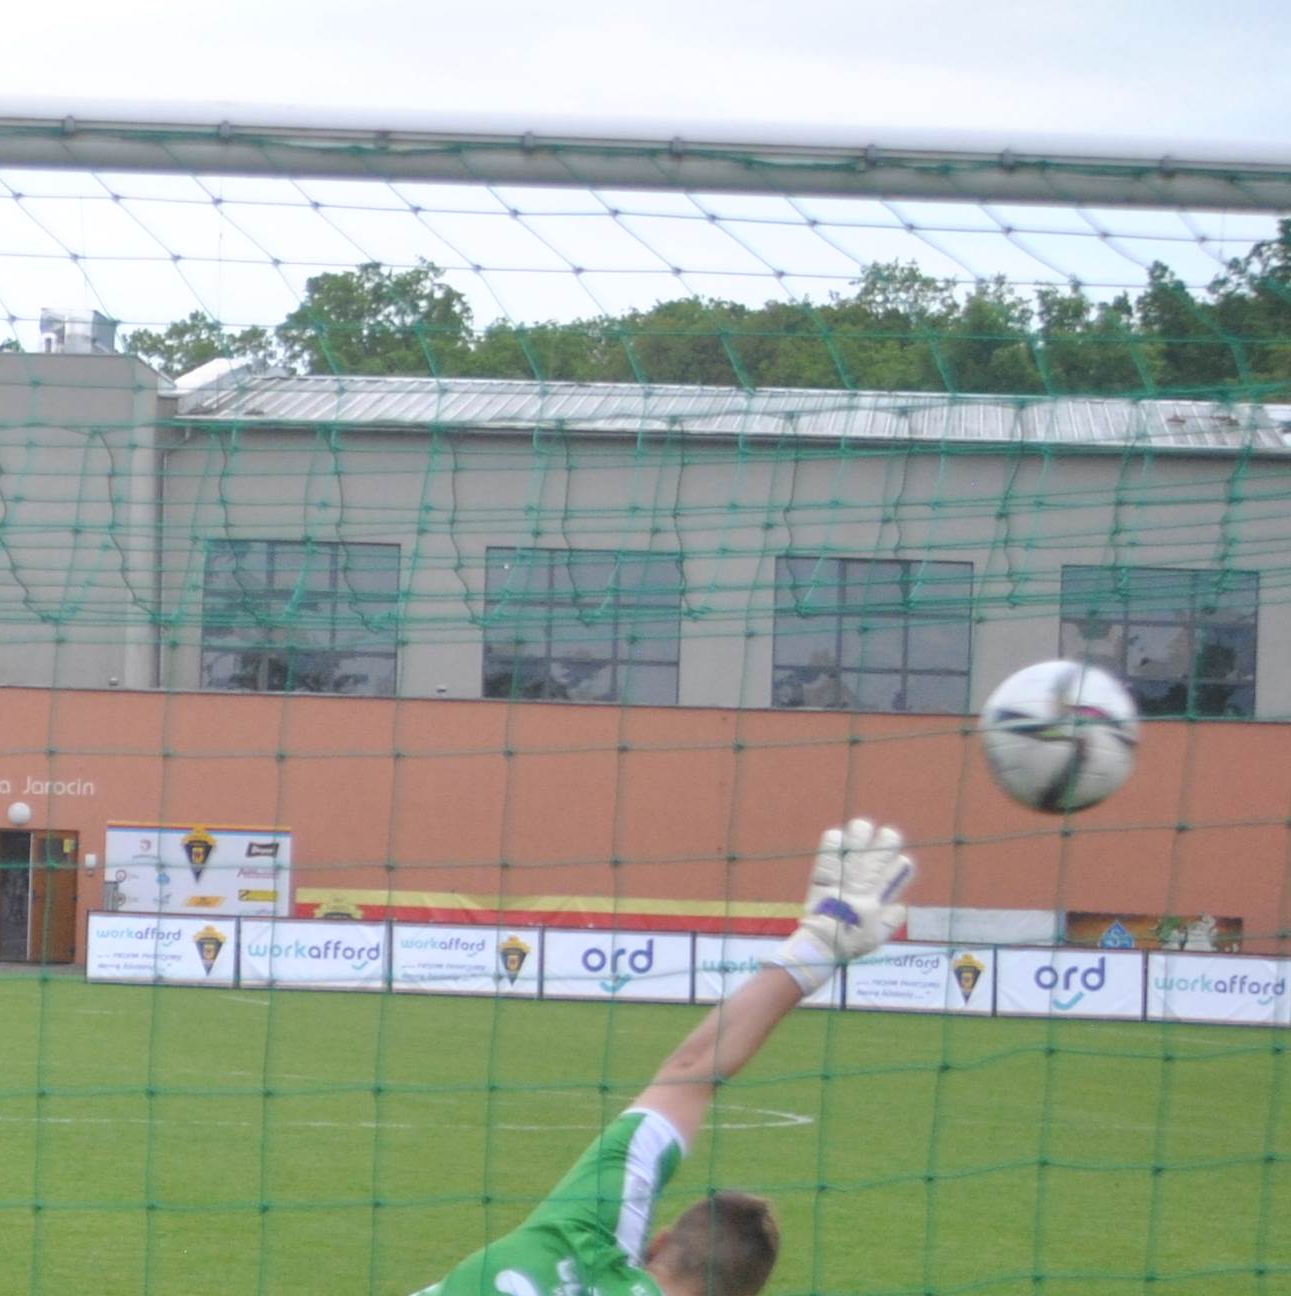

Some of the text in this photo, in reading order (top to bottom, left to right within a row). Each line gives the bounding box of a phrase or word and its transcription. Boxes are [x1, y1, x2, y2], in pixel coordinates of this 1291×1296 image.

[22, 776, 95, 796] Jarocin
[97, 927, 181, 941] workafford
[400, 937, 486, 952] workafford
[247, 940, 381, 961] workafford
[582, 938, 654, 974] ord
[1034, 956, 1106, 992] ord
[1154, 974, 1285, 996] workafford
